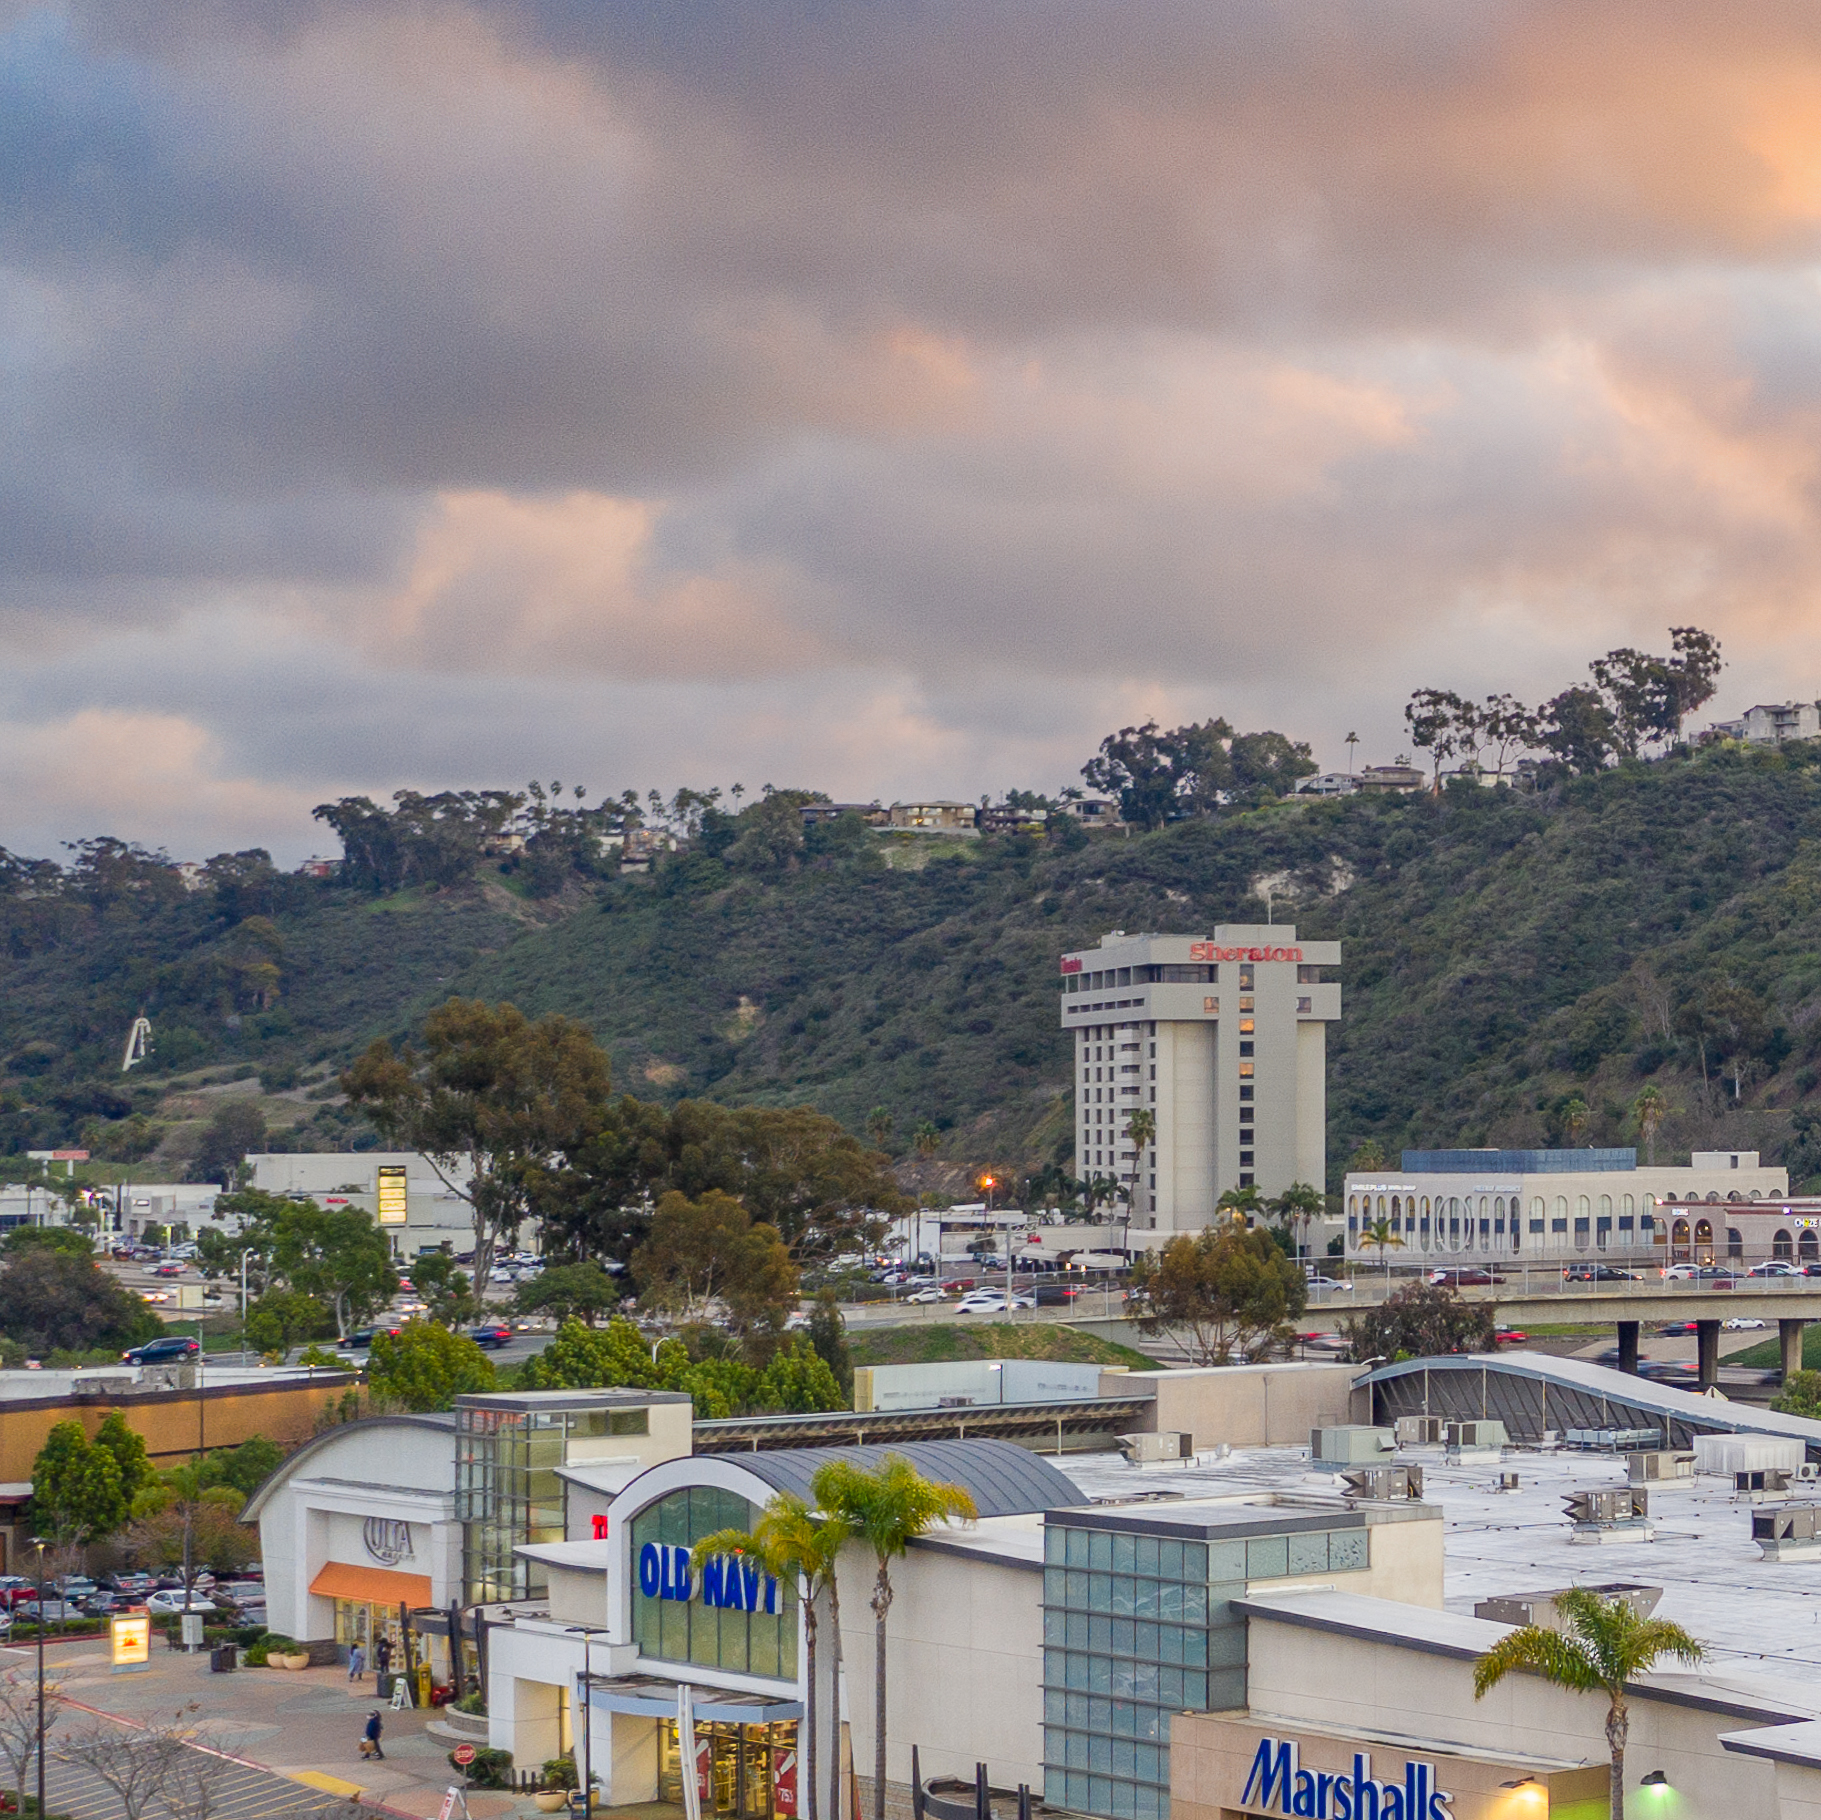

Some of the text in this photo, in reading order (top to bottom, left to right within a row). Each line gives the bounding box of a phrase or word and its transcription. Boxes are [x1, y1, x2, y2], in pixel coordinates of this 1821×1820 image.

[1189, 942, 1303, 962] Sheraton
[366, 1517, 414, 1558] ULTA
[640, 1542, 700, 1602] OLD
